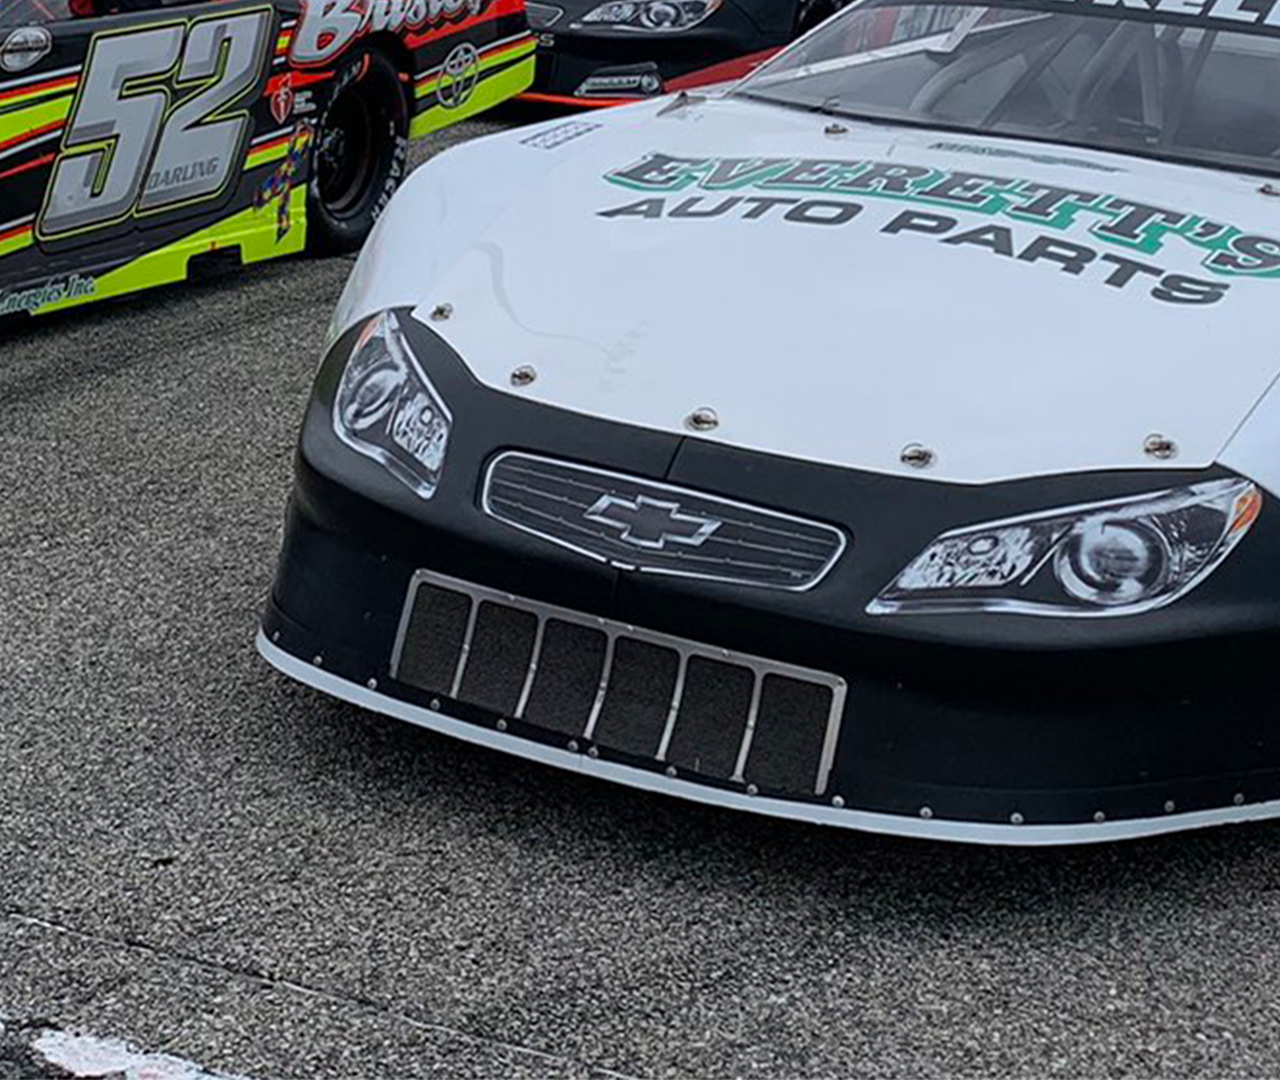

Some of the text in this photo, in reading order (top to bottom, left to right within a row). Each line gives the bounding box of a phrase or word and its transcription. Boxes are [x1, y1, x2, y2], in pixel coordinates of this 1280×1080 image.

[34, 4, 276, 242] 52
[148, 157, 220, 190] DARLING
[596, 196, 1231, 306] AUTO PARTS
